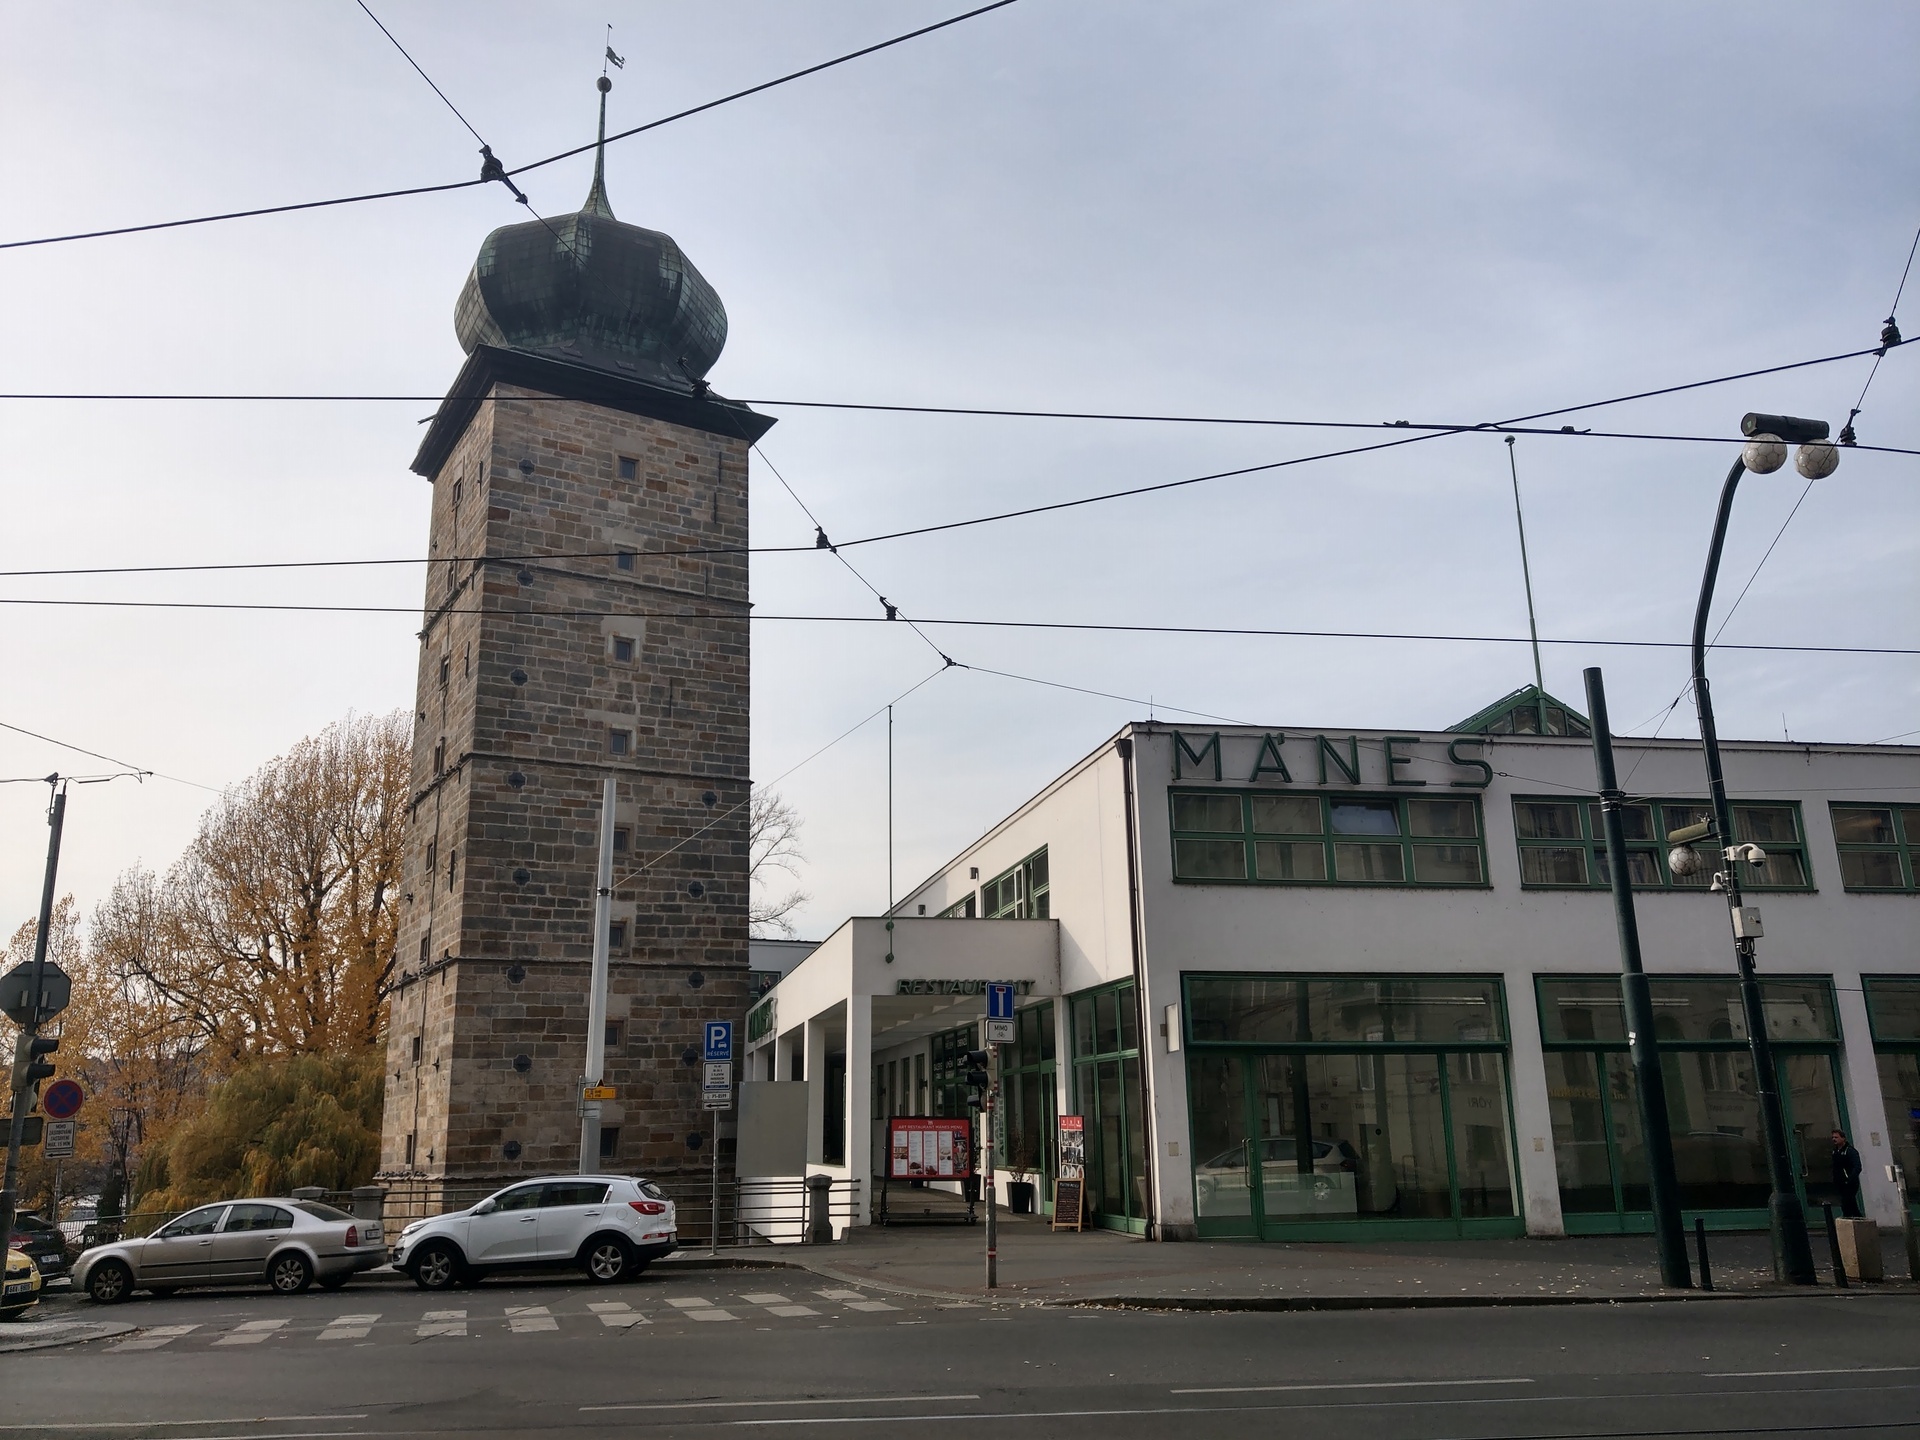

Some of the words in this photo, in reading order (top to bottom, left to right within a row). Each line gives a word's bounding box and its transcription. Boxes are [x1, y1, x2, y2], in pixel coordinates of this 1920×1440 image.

[1171, 729, 1494, 789] MÁNES
[897, 978, 1036, 996] RESTAURNT
[710, 1026, 727, 1049] P
